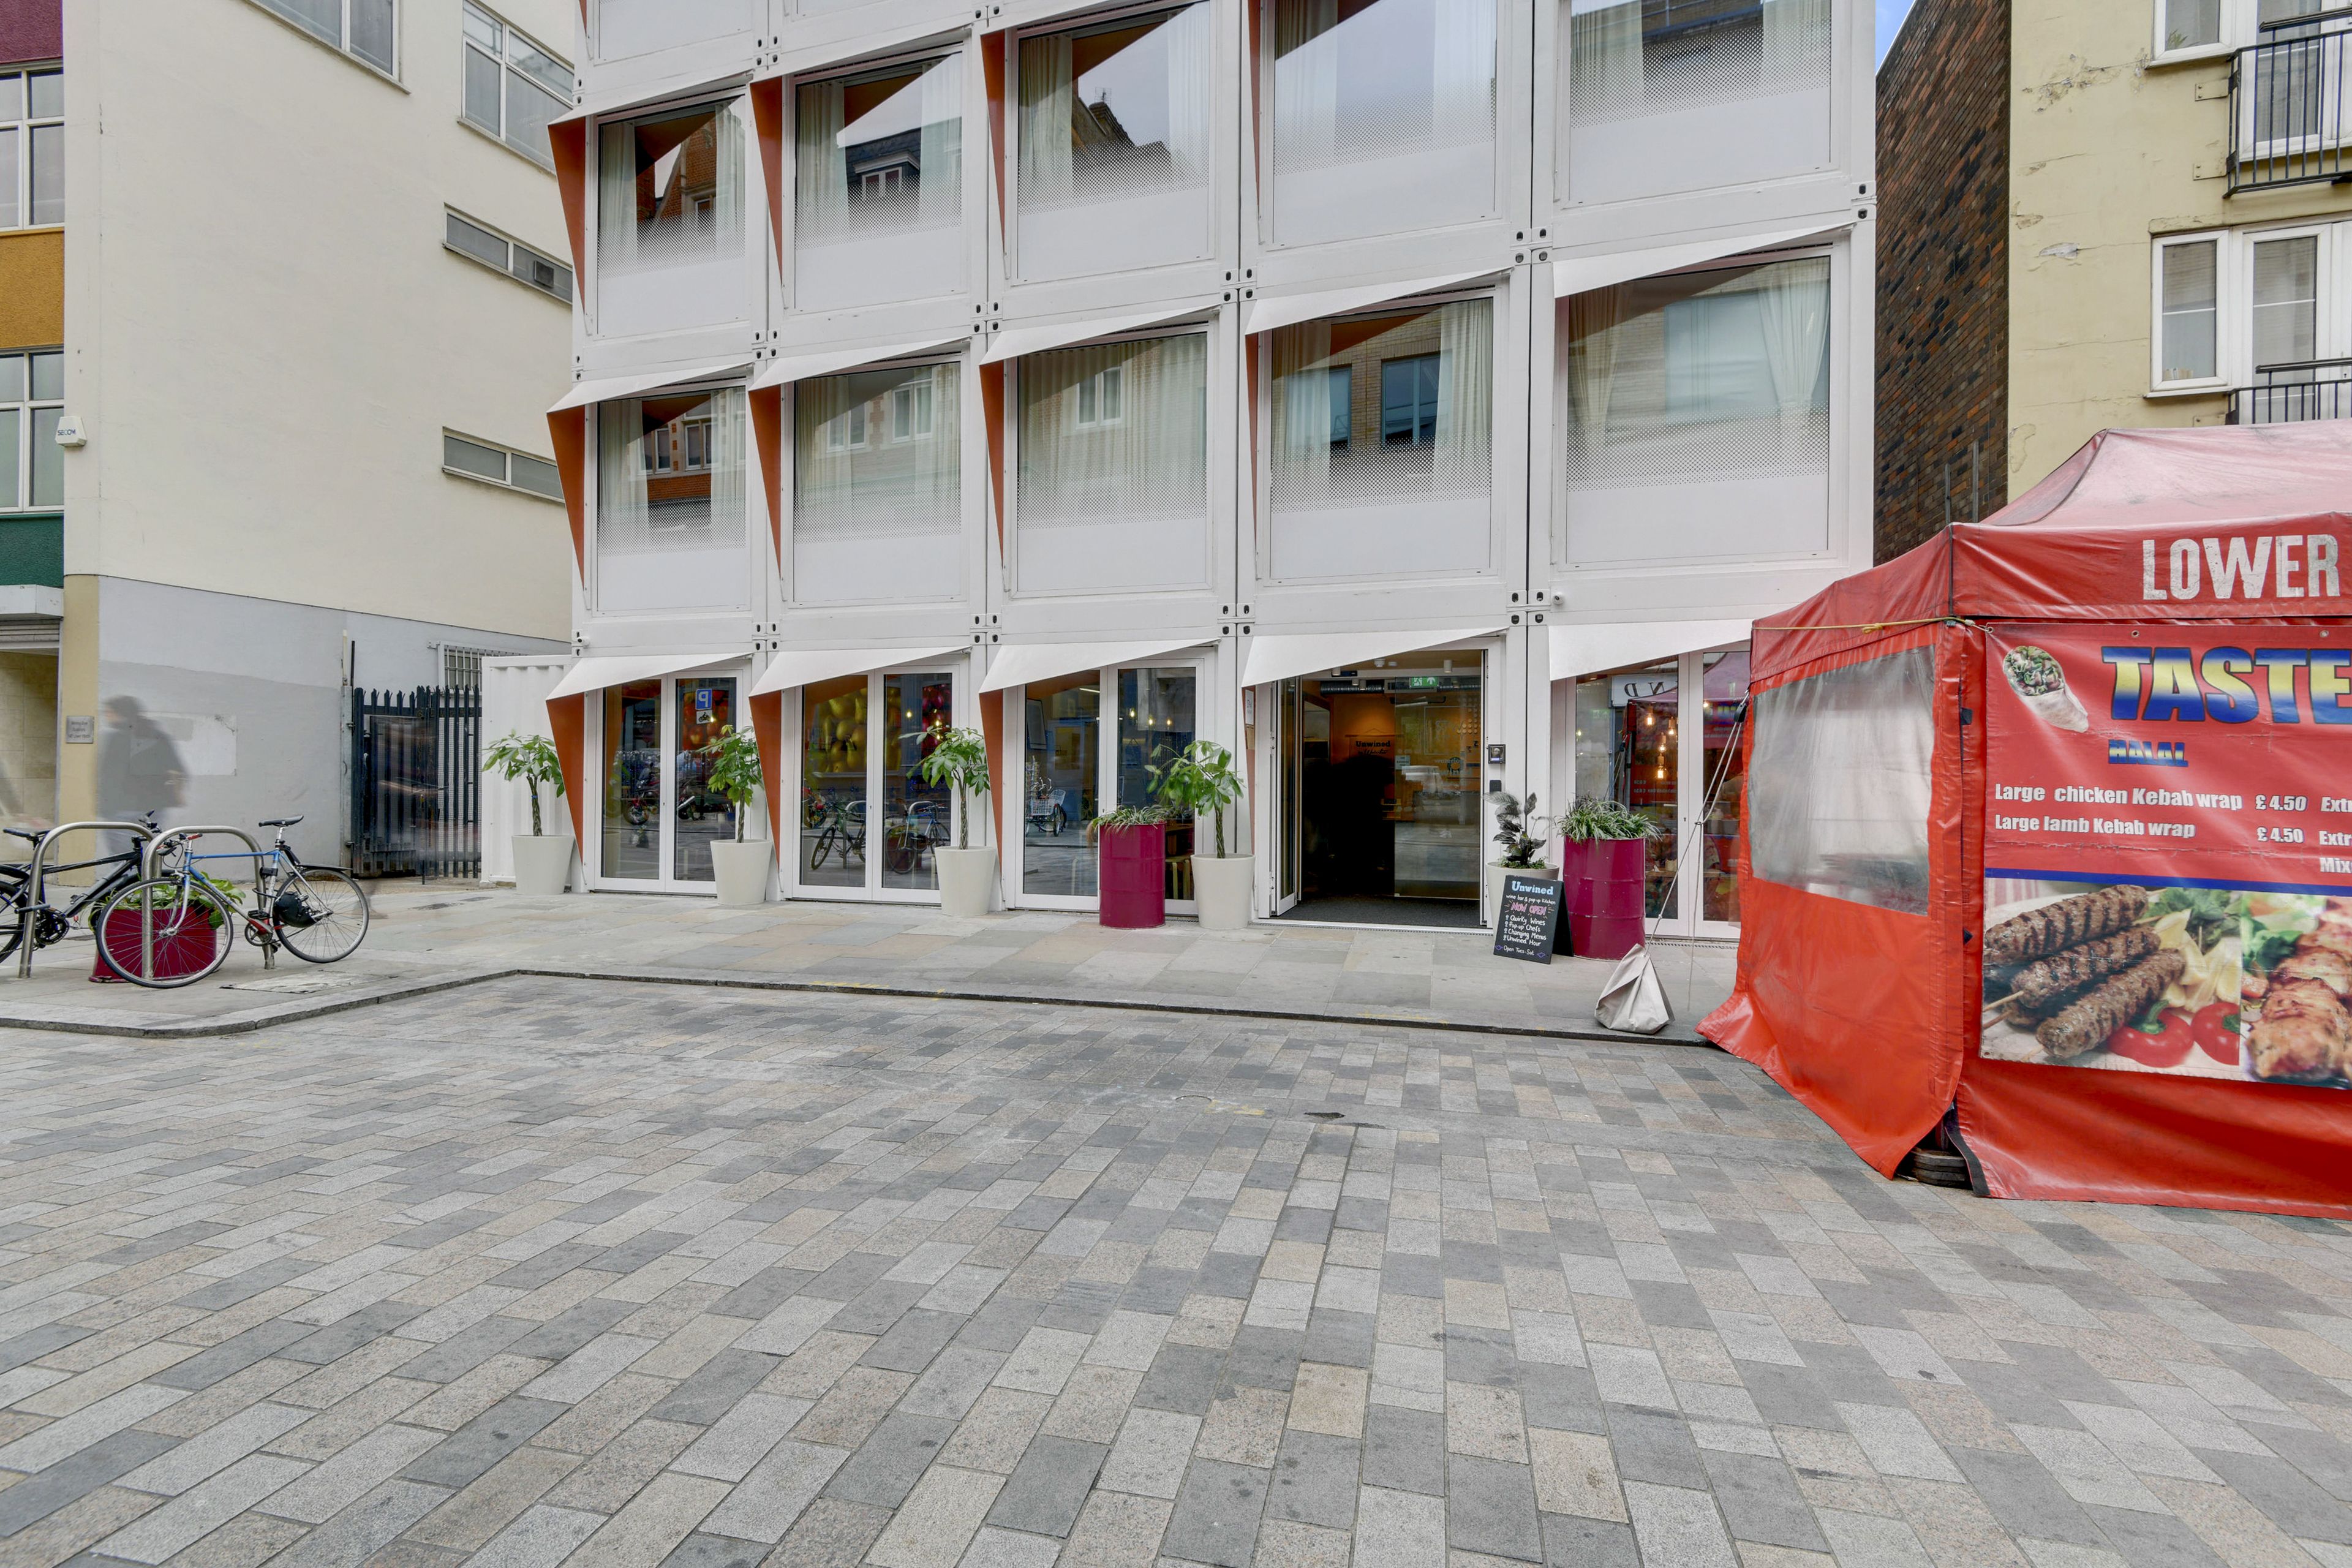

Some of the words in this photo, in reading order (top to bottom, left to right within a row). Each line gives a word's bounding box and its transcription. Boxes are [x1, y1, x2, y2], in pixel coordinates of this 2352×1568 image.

[2143, 534, 2340, 600] LOWER
[2101, 646, 2352, 725] TASTE
[2108, 739, 2189, 767] HALAL
[1995, 783, 2046, 802] Large
[2054, 785, 2128, 804] chicken
[2132, 788, 2193, 807] Kebab
[2195, 793, 2243, 810] wrap
[1995, 814, 2040, 832] Large
[2043, 816, 2090, 833] lamb
[2093, 818, 2144, 835] Kebab
[2148, 821, 2196, 839] wrap
[2319, 857, 2352, 873] Mix
[1512, 880, 1553, 895] Unwined
[1510, 902, 1528, 912] NOW
[1529, 905, 1547, 916] OPEN
[1509, 921, 1524, 930] Pop-up
[1507, 935, 1527, 944] Unwined
[1508, 929, 1529, 940] Changing
